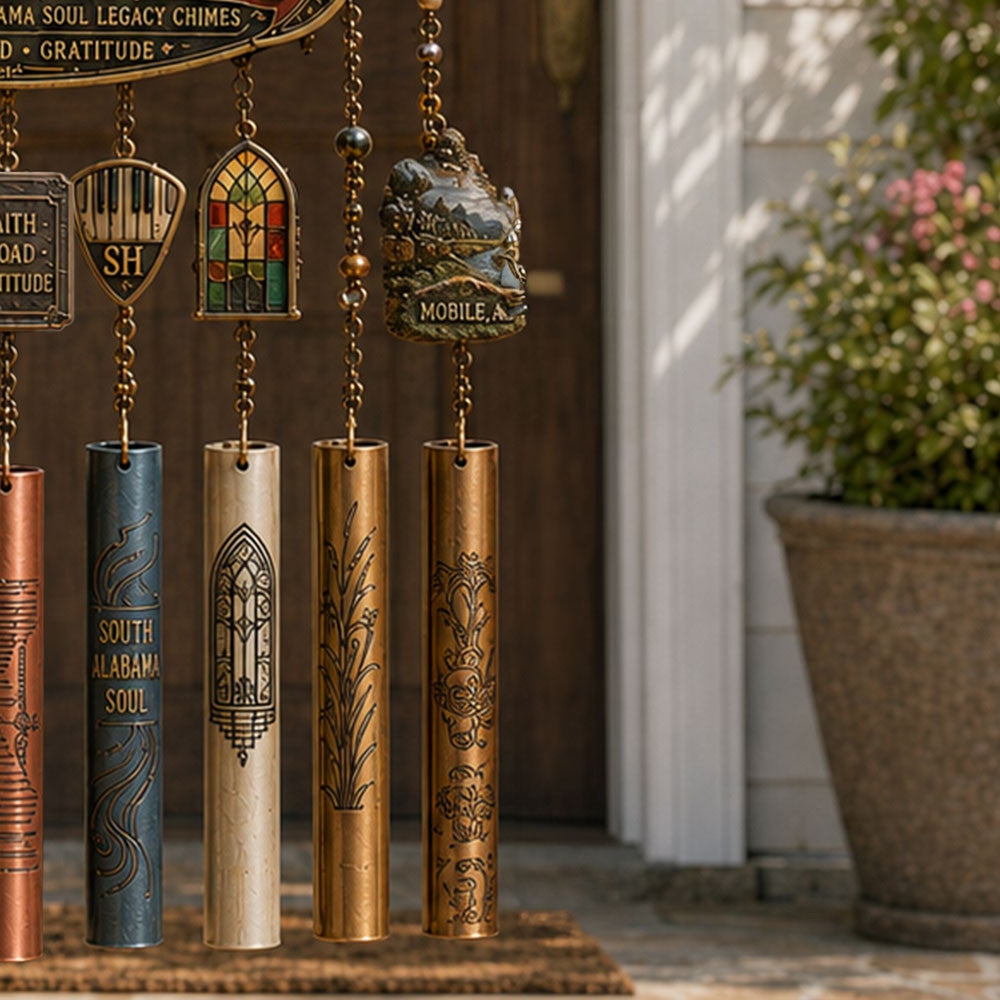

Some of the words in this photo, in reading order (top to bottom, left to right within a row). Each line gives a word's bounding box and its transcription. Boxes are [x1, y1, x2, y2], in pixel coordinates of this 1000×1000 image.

[42, 5, 89, 25] SOUL
[97, 5, 166, 26] LEGACY
[172, 6, 241, 27] CHIMES
[40, 40, 154, 61] GRATITUDE
[103, 245, 144, 277] SH
[99, 619, 153, 644] SOUTH
[92, 652, 160, 679] ALABAMA
[105, 688, 148, 713] SOUL
